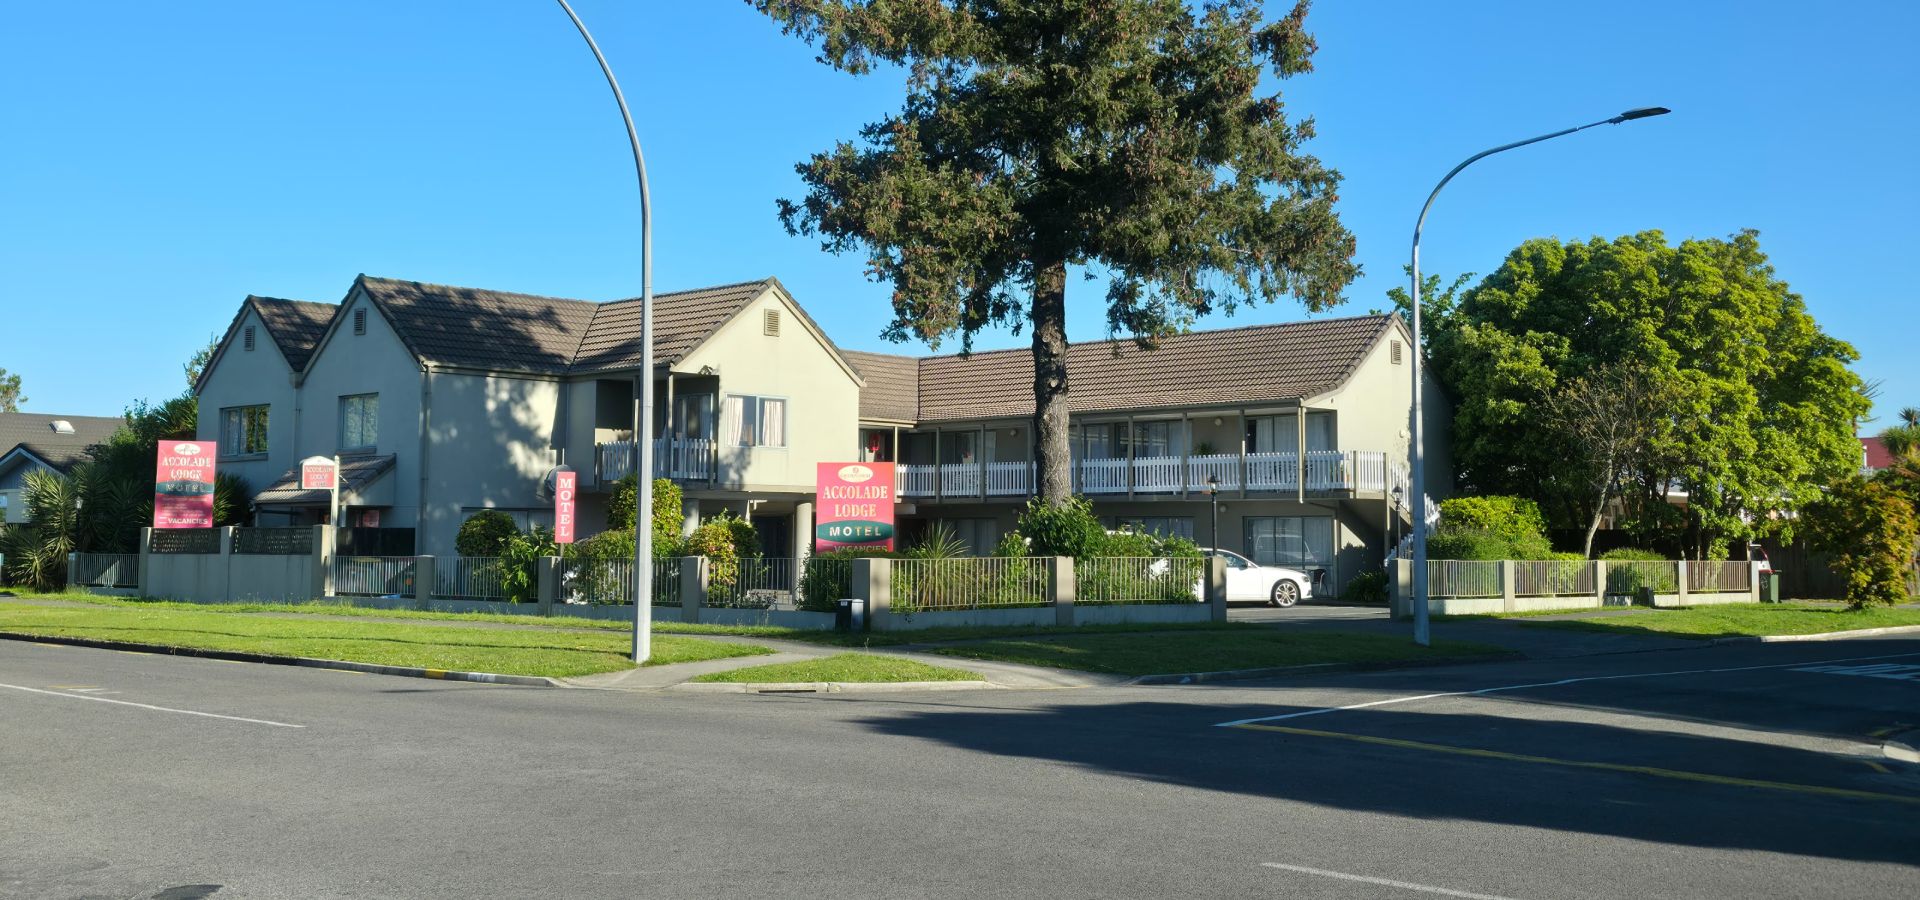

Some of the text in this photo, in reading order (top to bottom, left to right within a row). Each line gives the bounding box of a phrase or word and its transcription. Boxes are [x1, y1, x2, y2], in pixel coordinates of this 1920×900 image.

[162, 457, 211, 468] ACCOLADE
[170, 468, 203, 480] LODGE
[823, 486, 888, 499] ACCOLADE
[560, 478, 573, 537] MOTEL
[834, 503, 877, 518] LODGE
[167, 517, 209, 525] VACANCIES
[829, 526, 882, 537] MOTEL
